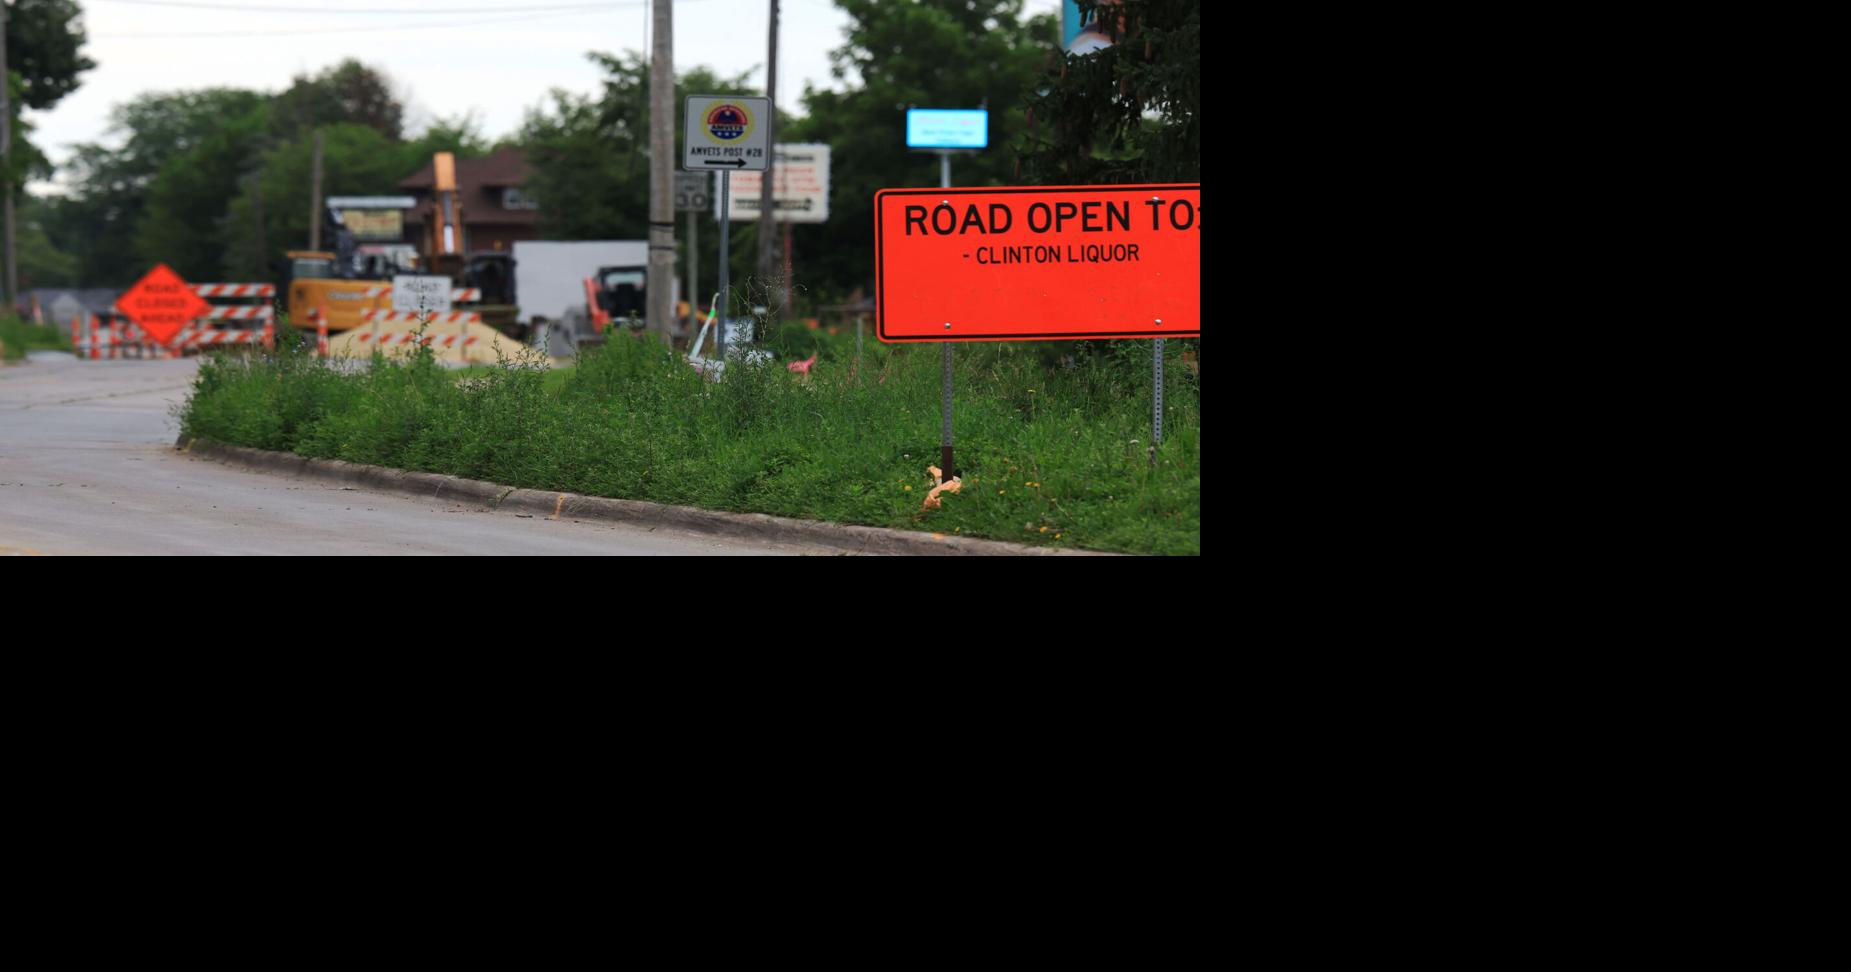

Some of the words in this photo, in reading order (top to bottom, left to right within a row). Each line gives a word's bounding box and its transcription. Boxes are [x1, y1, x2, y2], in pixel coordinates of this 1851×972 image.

[690, 147, 720, 156] AMVETS
[723, 148, 743, 157] POST
[746, 148, 763, 158] #28
[905, 202, 1013, 236] ROAD
[1027, 200, 1131, 233] OPEN
[976, 246, 1061, 265] CLINTON
[1067, 244, 1140, 263] LIQUOR
[144, 283, 179, 293] ROAD
